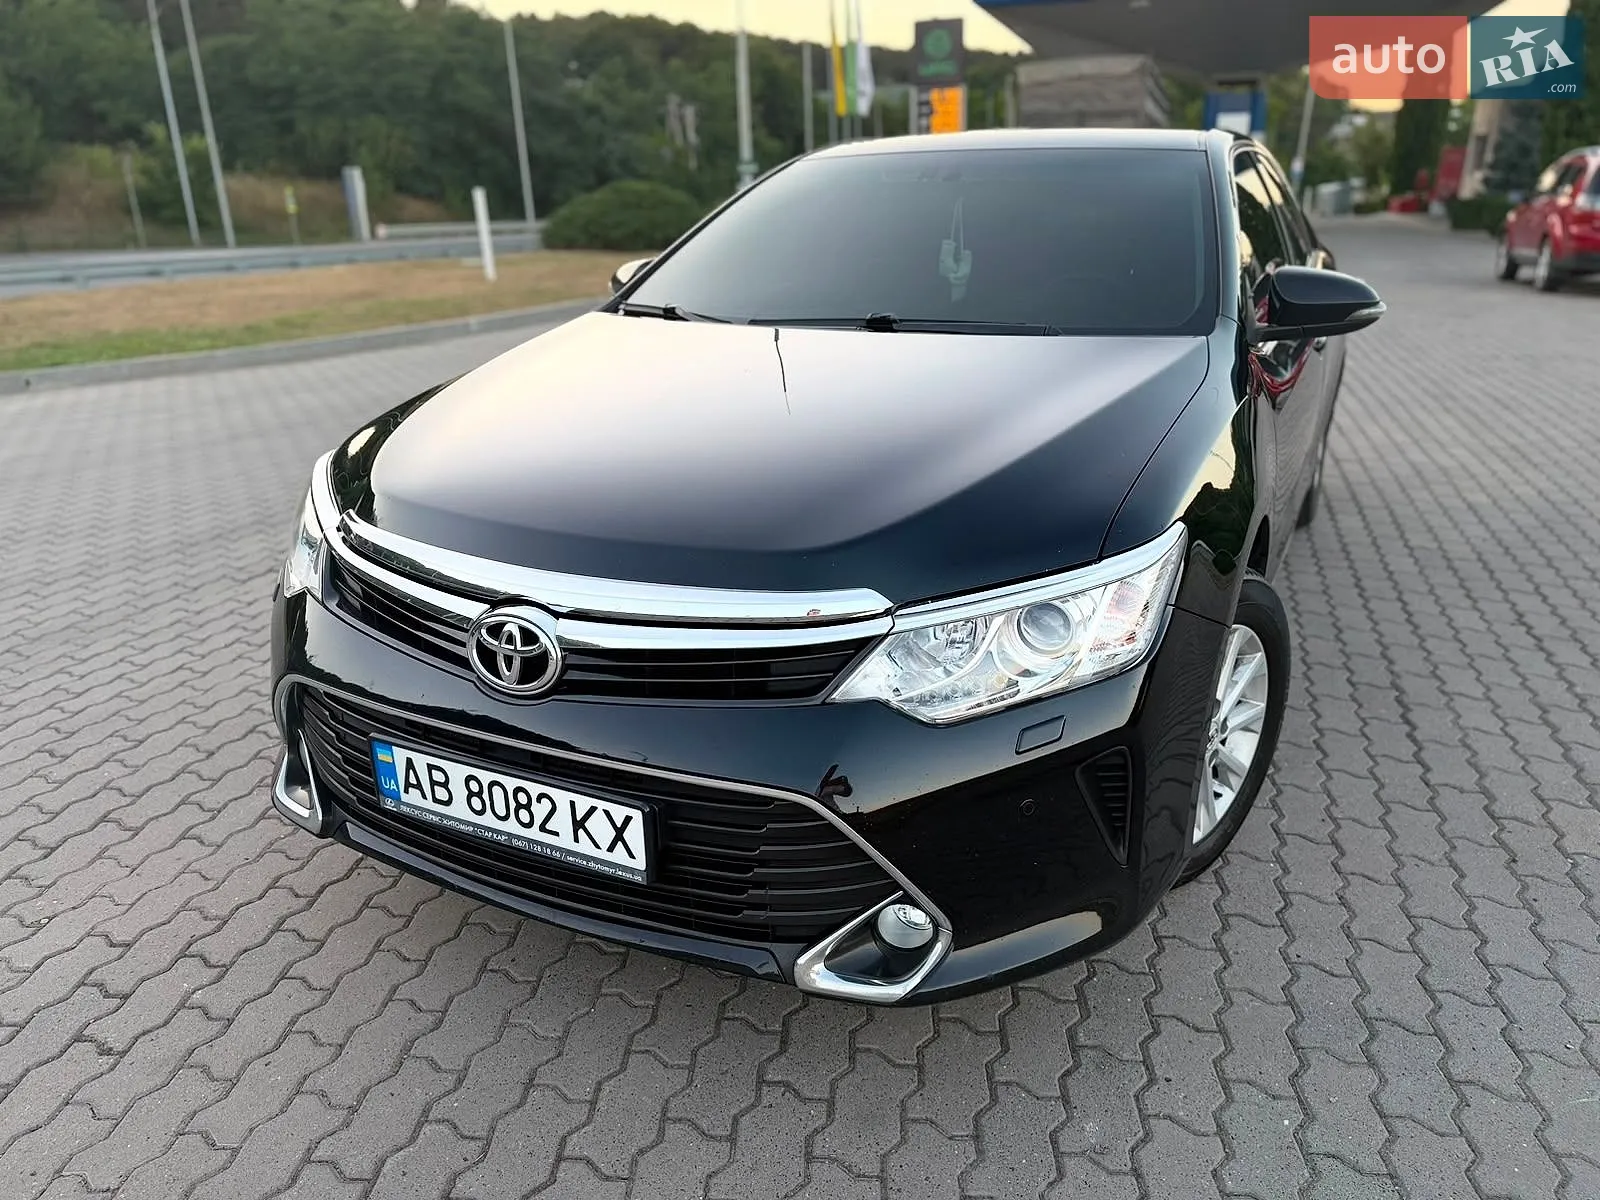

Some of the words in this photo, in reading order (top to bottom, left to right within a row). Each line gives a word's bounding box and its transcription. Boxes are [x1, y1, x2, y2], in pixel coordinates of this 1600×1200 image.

[381, 776, 399, 792] UA
[403, 756, 454, 807] AB
[464, 774, 560, 837] 8082
[569, 799, 637, 860] KX
[511, 838, 528, 849] (067)
[530, 843, 542, 852] 128
[543, 847, 551, 855] 18
